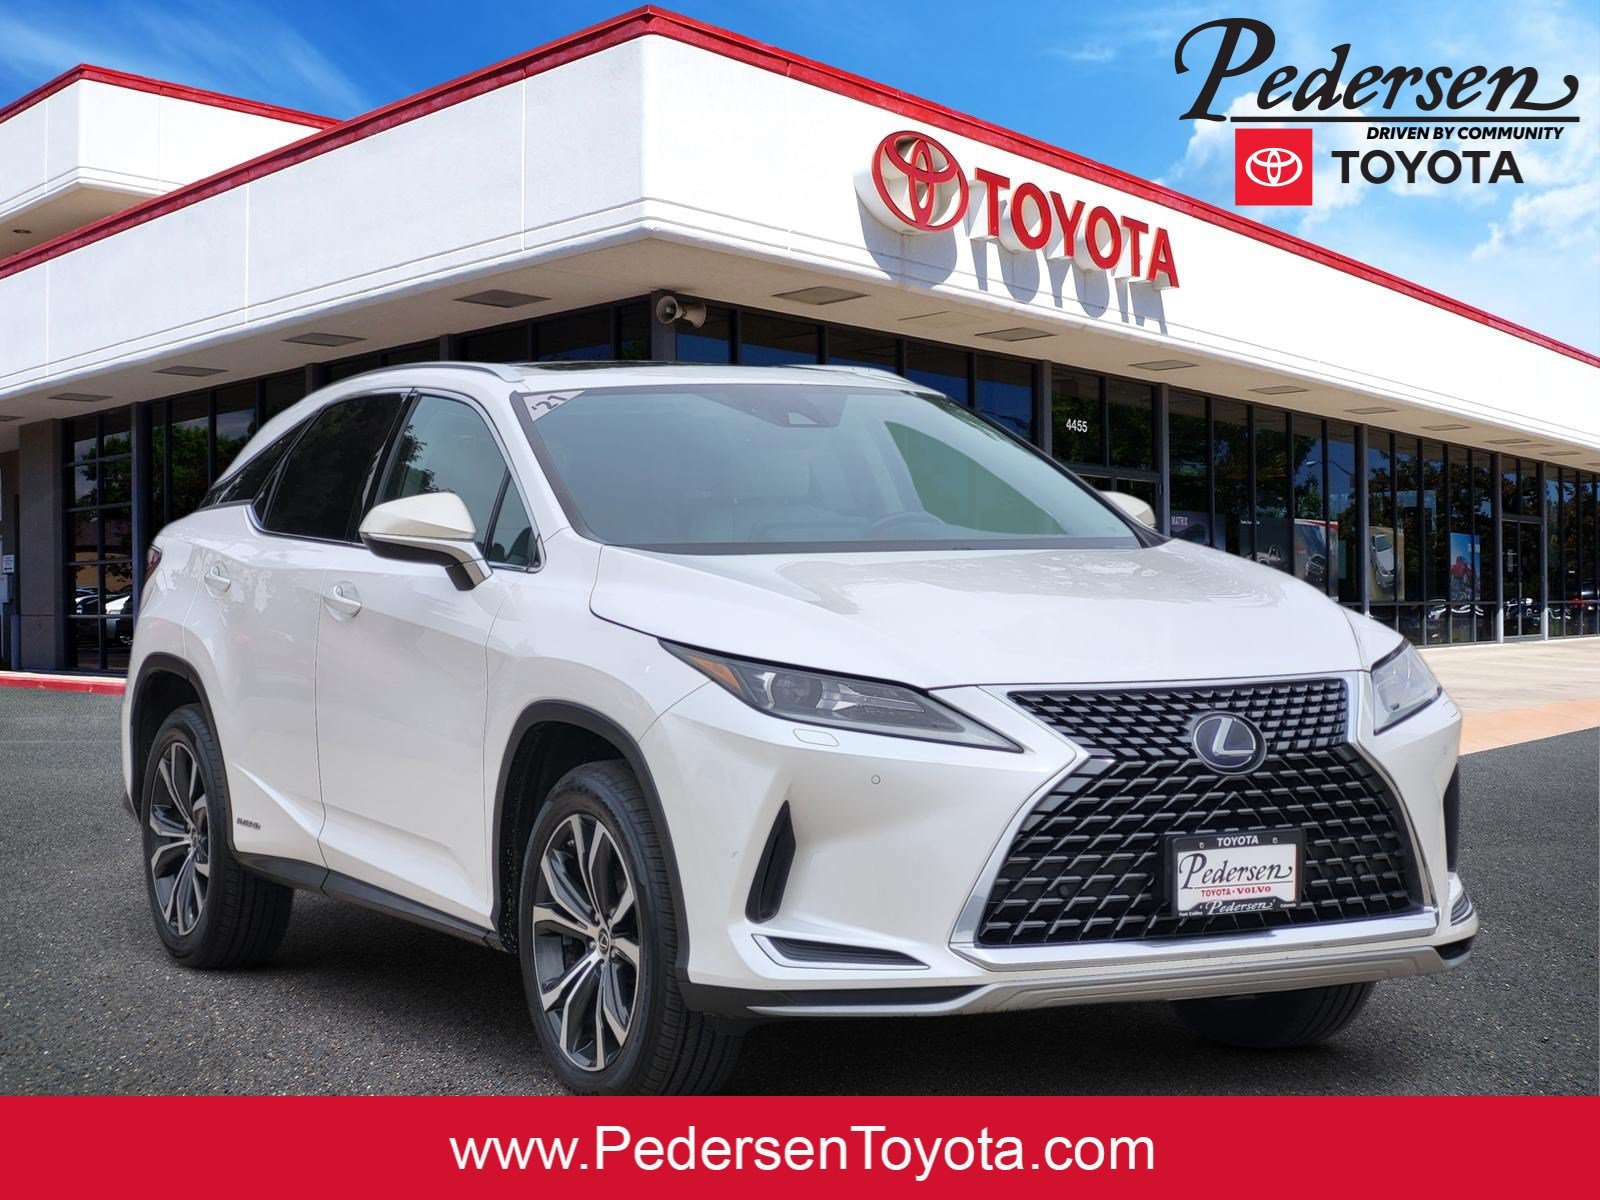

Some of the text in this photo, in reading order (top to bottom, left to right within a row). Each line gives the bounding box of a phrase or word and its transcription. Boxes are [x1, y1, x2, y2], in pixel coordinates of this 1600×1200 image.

[975, 167, 1180, 289] TOYOTA
[1065, 418, 1088, 434] 4455
[1217, 835, 1259, 847] TOYOTA
[1179, 852, 1293, 890] Pedersen
[1201, 886, 1271, 897] TOYOTA VOLVO
[1205, 900, 1273, 915] Pedersen
